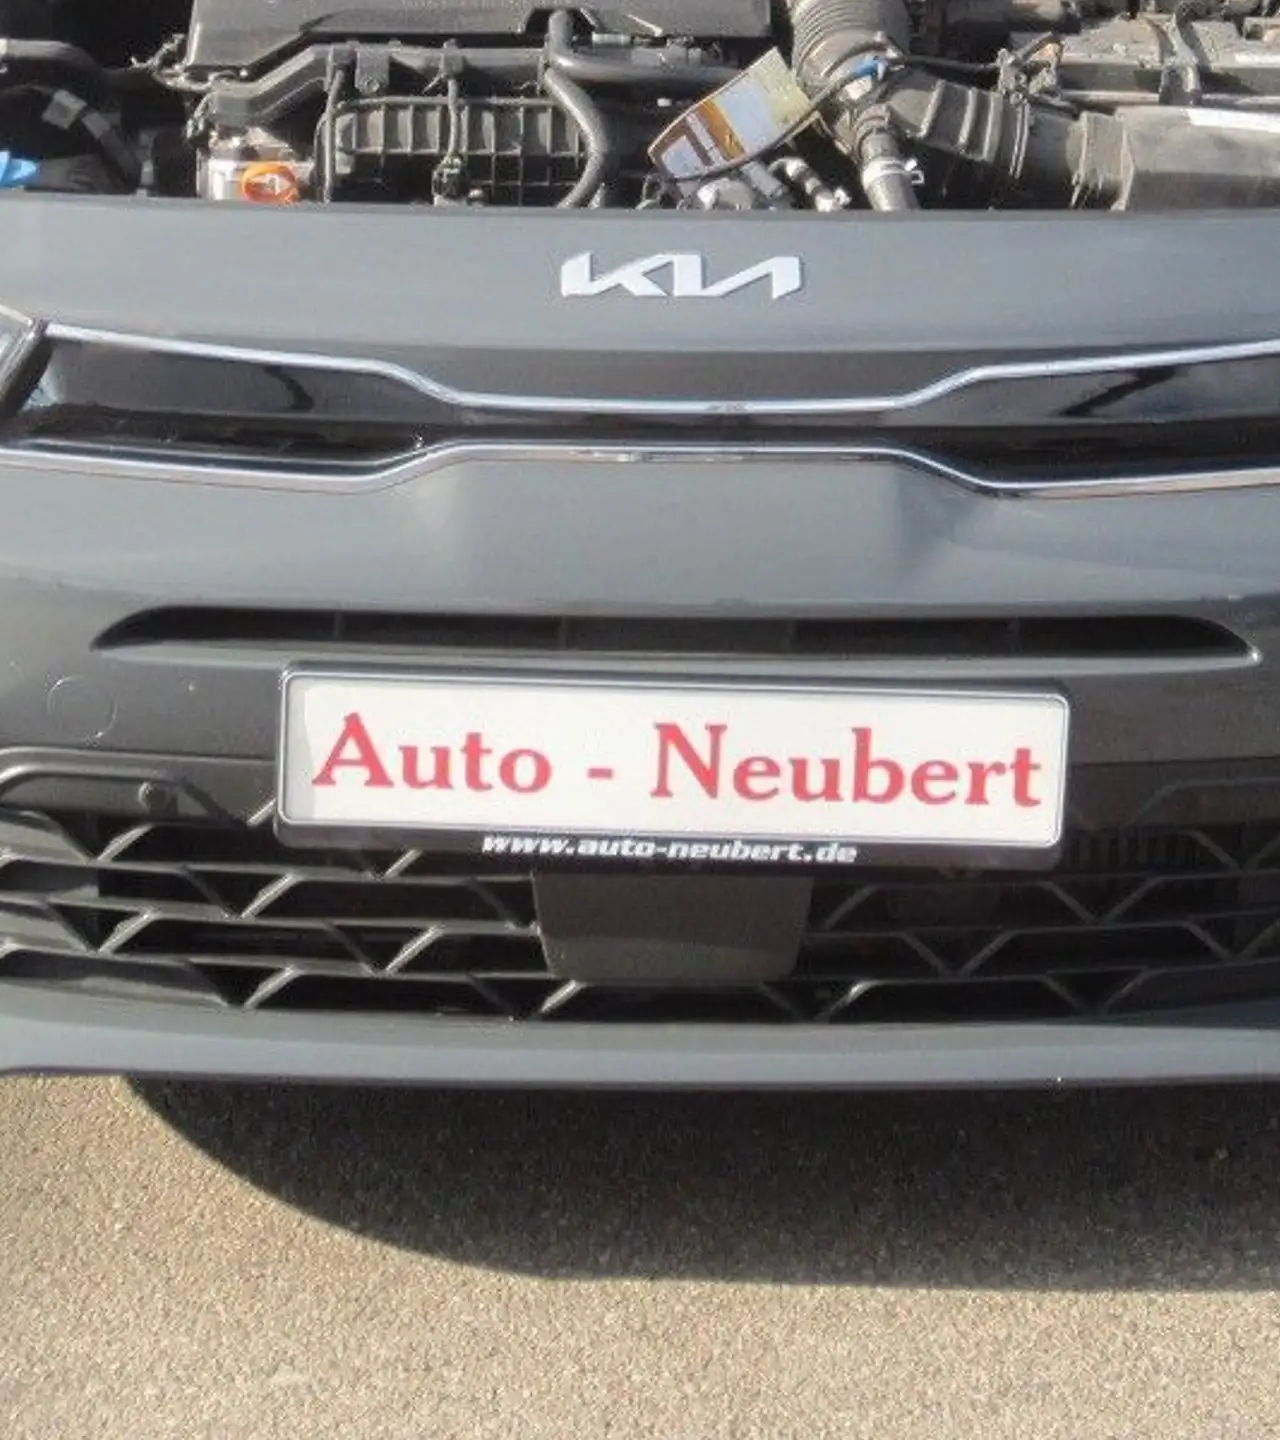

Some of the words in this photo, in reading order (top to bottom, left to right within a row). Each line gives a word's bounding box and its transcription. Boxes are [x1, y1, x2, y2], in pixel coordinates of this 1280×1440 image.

[561, 252, 802, 300] KIA
[313, 712, 552, 793] Auto
[651, 722, 1041, 807] Neubert
[482, 835, 858, 863] www.auto-neubert.de
